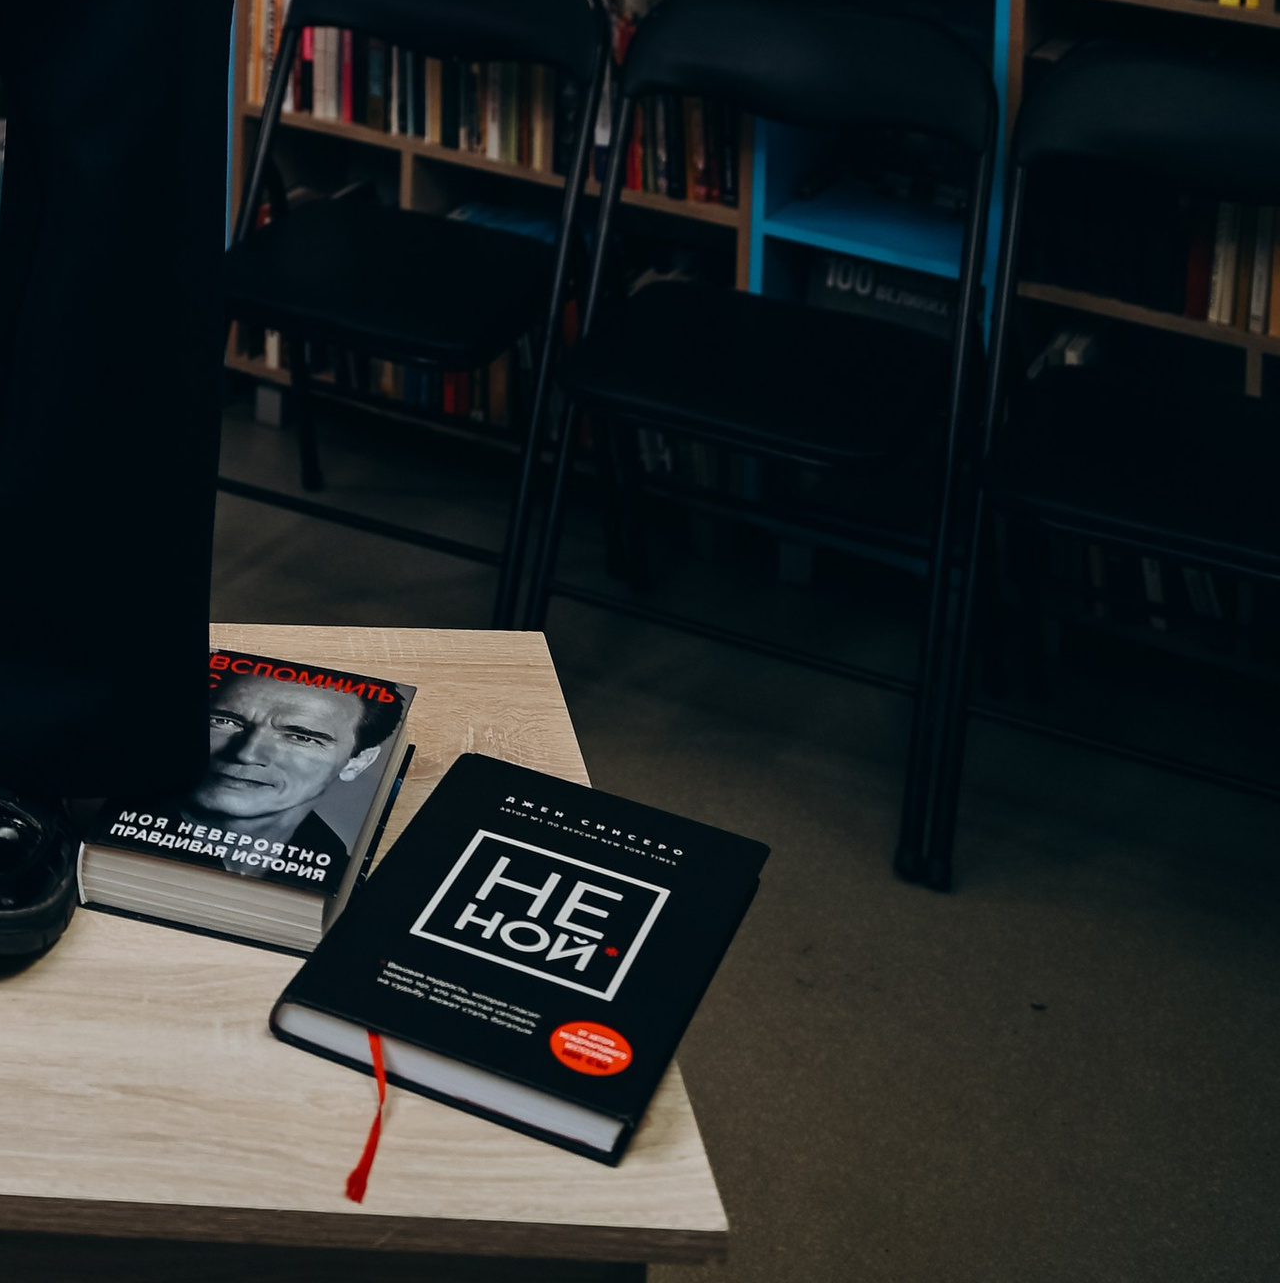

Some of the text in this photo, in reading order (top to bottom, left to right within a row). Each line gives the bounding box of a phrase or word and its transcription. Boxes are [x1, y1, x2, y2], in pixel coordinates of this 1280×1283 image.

[824, 259, 875, 297] 100
[209, 654, 396, 704] ВСПОМНИТЬ
[109, 823, 327, 883] ПРАВДИВАЯ ИСТОРИЯ
[118, 810, 332, 868] МОЯ НЕВЕРОЯТНО
[499, 805, 528, 818] АВТОР
[547, 821, 560, 829] ПО
[562, 825, 599, 840] ВЕРСИИ
[601, 837, 621, 848] NEW
[623, 845, 646, 857] YORK
[650, 853, 677, 867] TIMES
[505, 795, 684, 857] ДЖЕН СИНСЕРО
[474, 855, 624, 940] НЕ
[453, 902, 599, 972] НОЙ
